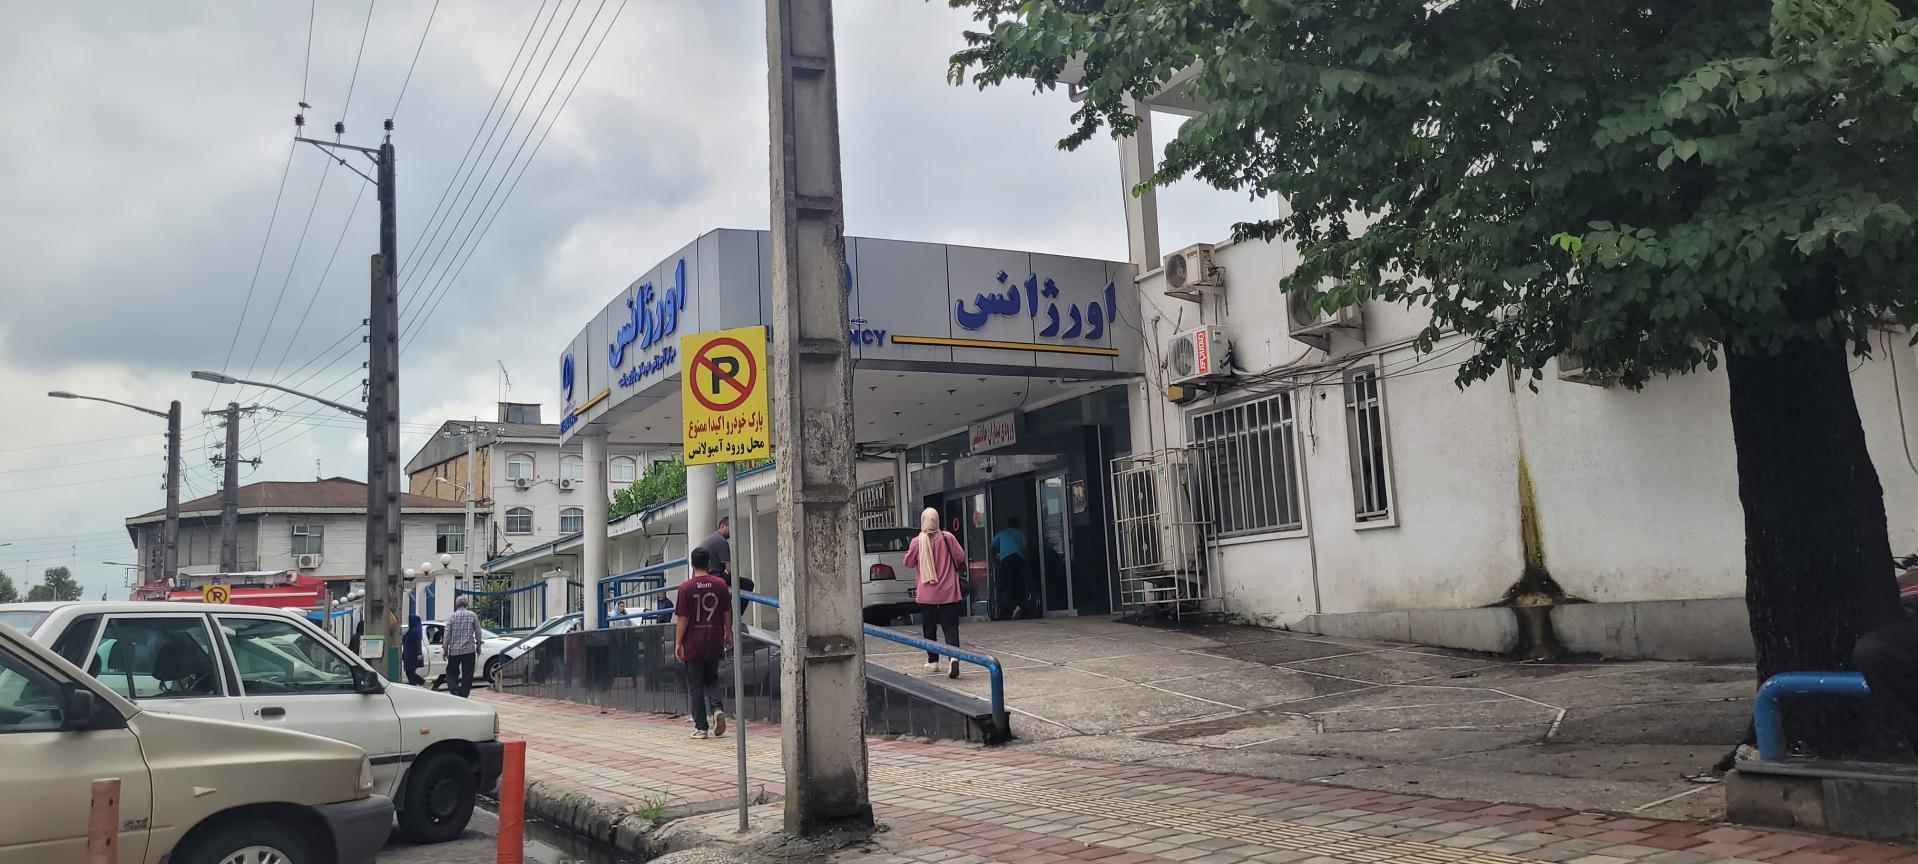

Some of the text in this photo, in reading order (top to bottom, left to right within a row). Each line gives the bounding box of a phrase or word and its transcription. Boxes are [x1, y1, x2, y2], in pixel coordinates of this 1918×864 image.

[608, 257, 686, 369] اورژانس
[955, 269, 1117, 340] اورژانس
[848, 329, 887, 347] NCY
[712, 356, 740, 395] P
[688, 411, 764, 439] پارک خودرو اکیدا ممنوع
[688, 437, 765, 459] محل ورود آمبولانس
[692, 592, 719, 622] 19
